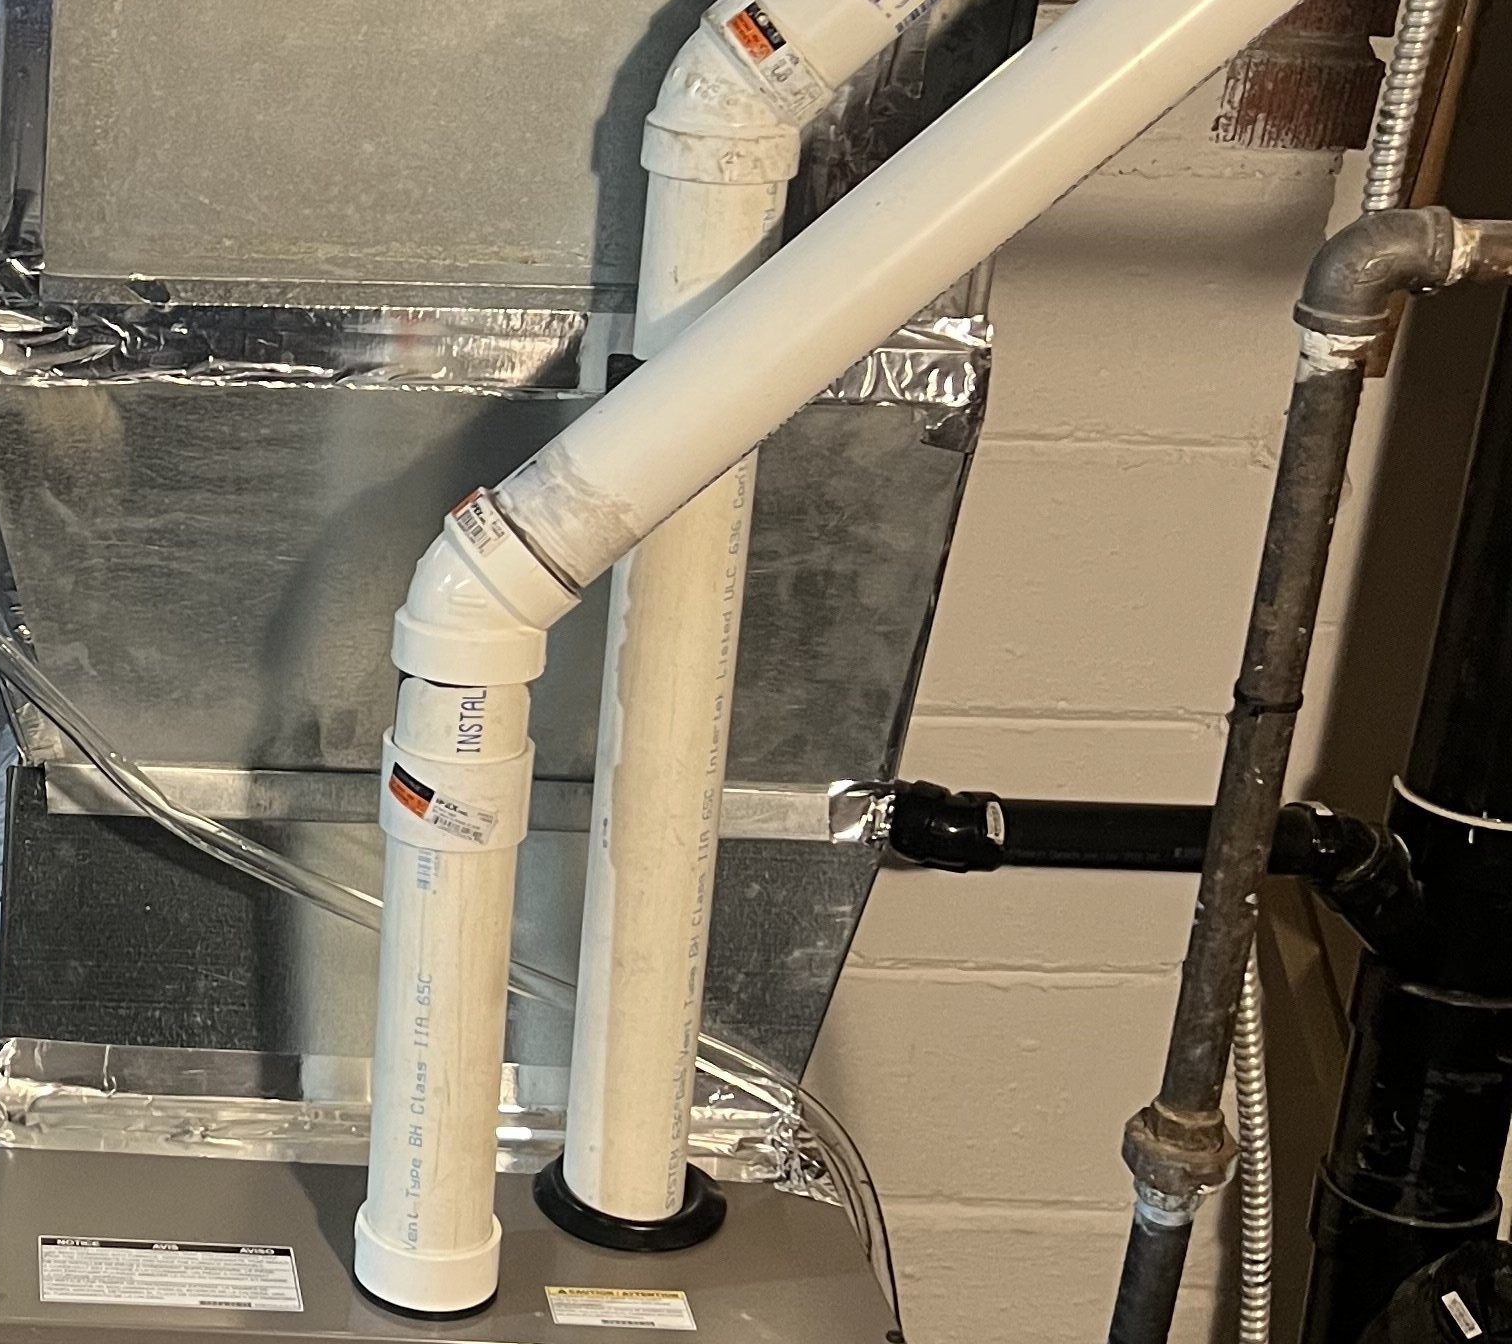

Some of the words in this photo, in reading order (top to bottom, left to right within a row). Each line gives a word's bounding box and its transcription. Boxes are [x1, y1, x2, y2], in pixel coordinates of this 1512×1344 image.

[418, 972, 433, 1005] 65C
[410, 1060, 428, 1116] Class
[408, 1126, 422, 1149] BH
[405, 1158, 423, 1200] Type
[152, 1242, 180, 1251] AVIS
[239, 1247, 276, 1255] AVISO
